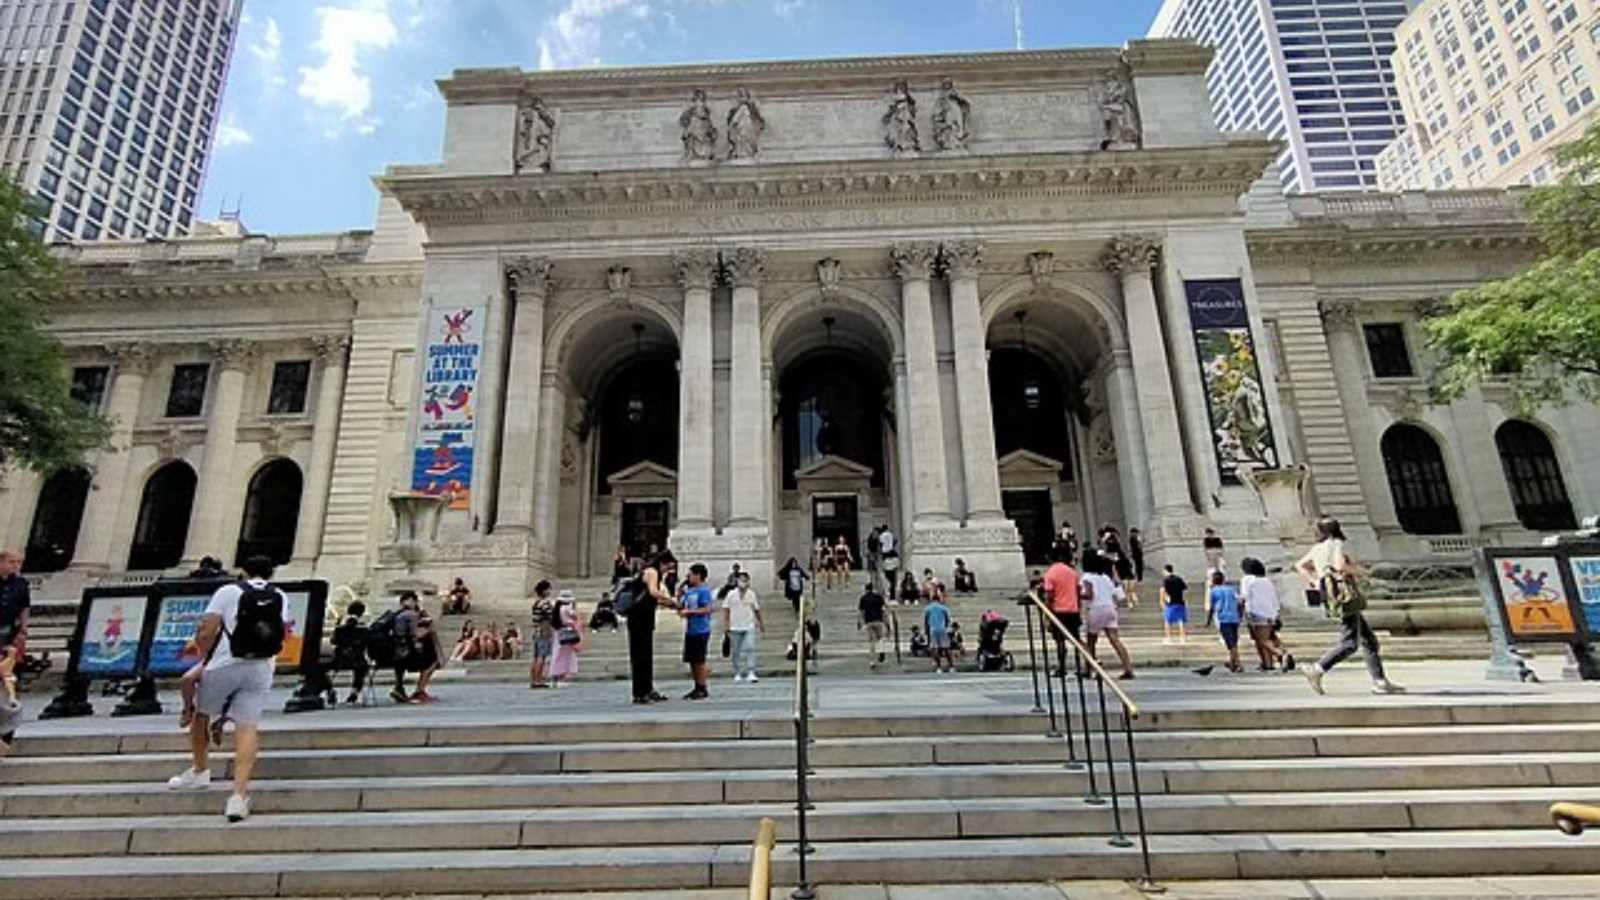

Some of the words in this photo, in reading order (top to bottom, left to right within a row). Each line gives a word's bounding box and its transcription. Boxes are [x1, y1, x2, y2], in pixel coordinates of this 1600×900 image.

[696, 213, 745, 231] NEW
[767, 211, 825, 229] YORK
[933, 205, 1024, 222] LIBRARY
[1191, 301, 1243, 309] TREASURES
[429, 344, 478, 357] SUMMER
[433, 357, 449, 369] AT
[451, 356, 473, 369] THE
[426, 369, 477, 382] LIBRARY
